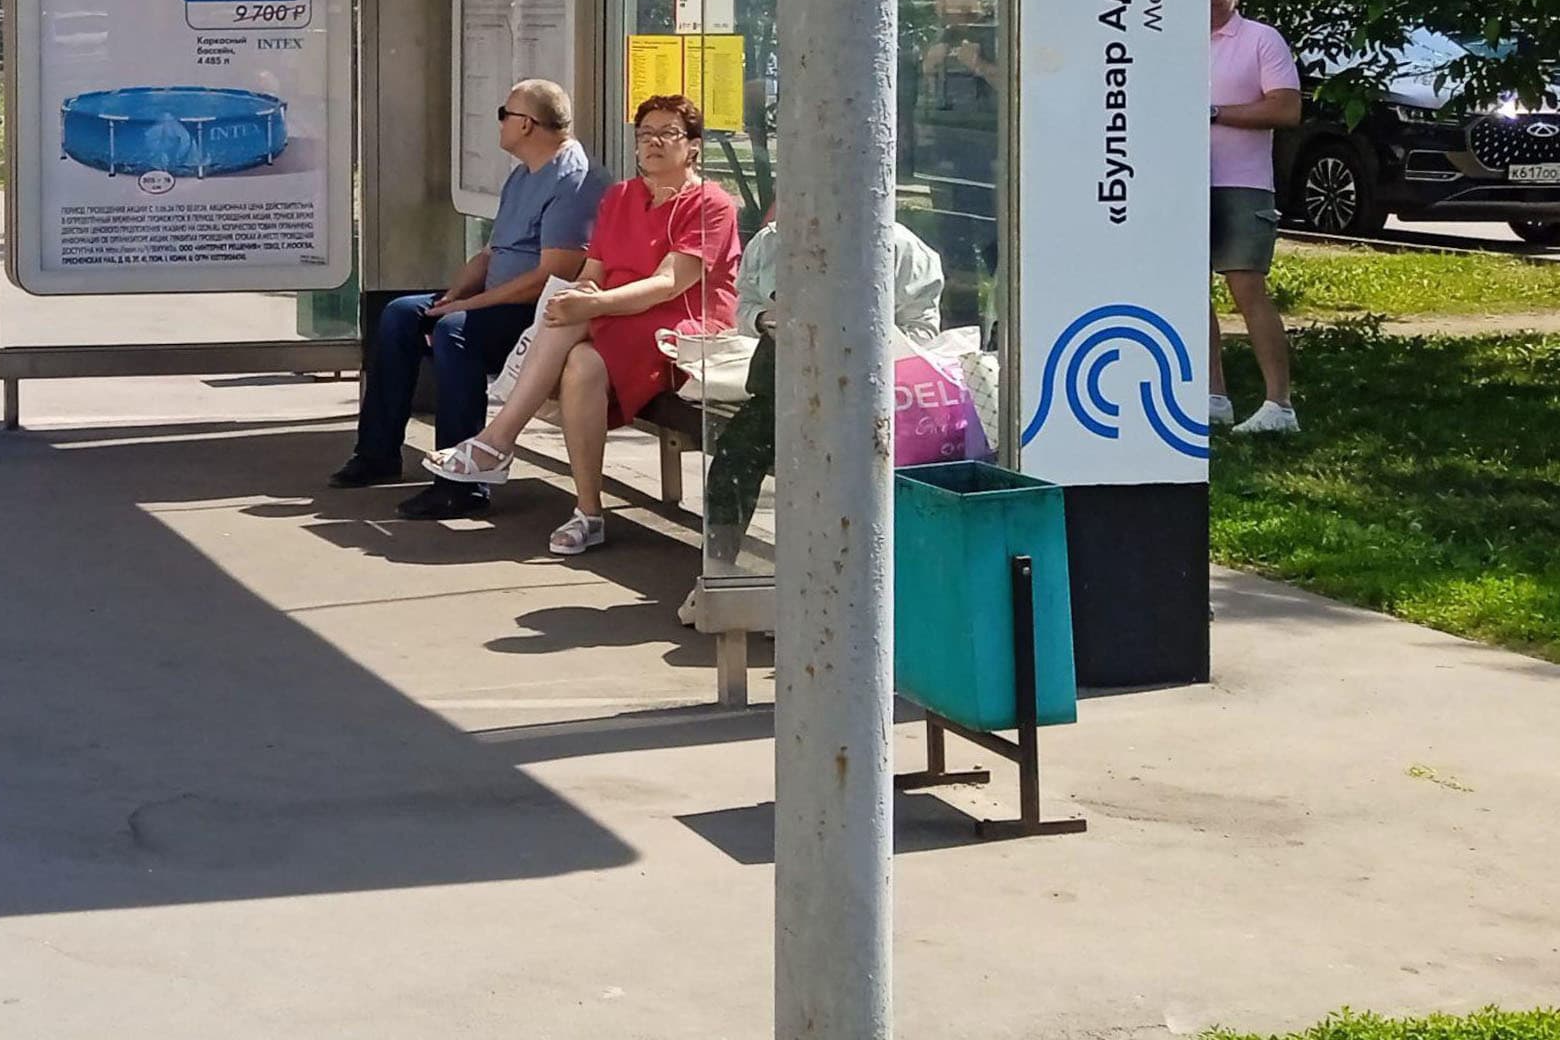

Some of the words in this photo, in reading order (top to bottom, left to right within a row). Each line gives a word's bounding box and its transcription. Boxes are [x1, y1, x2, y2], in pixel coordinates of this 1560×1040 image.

[251, 5, 288, 22] 700
[257, 38, 304, 49] INTEX
[1098, 41, 1134, 225] «Бульвар
